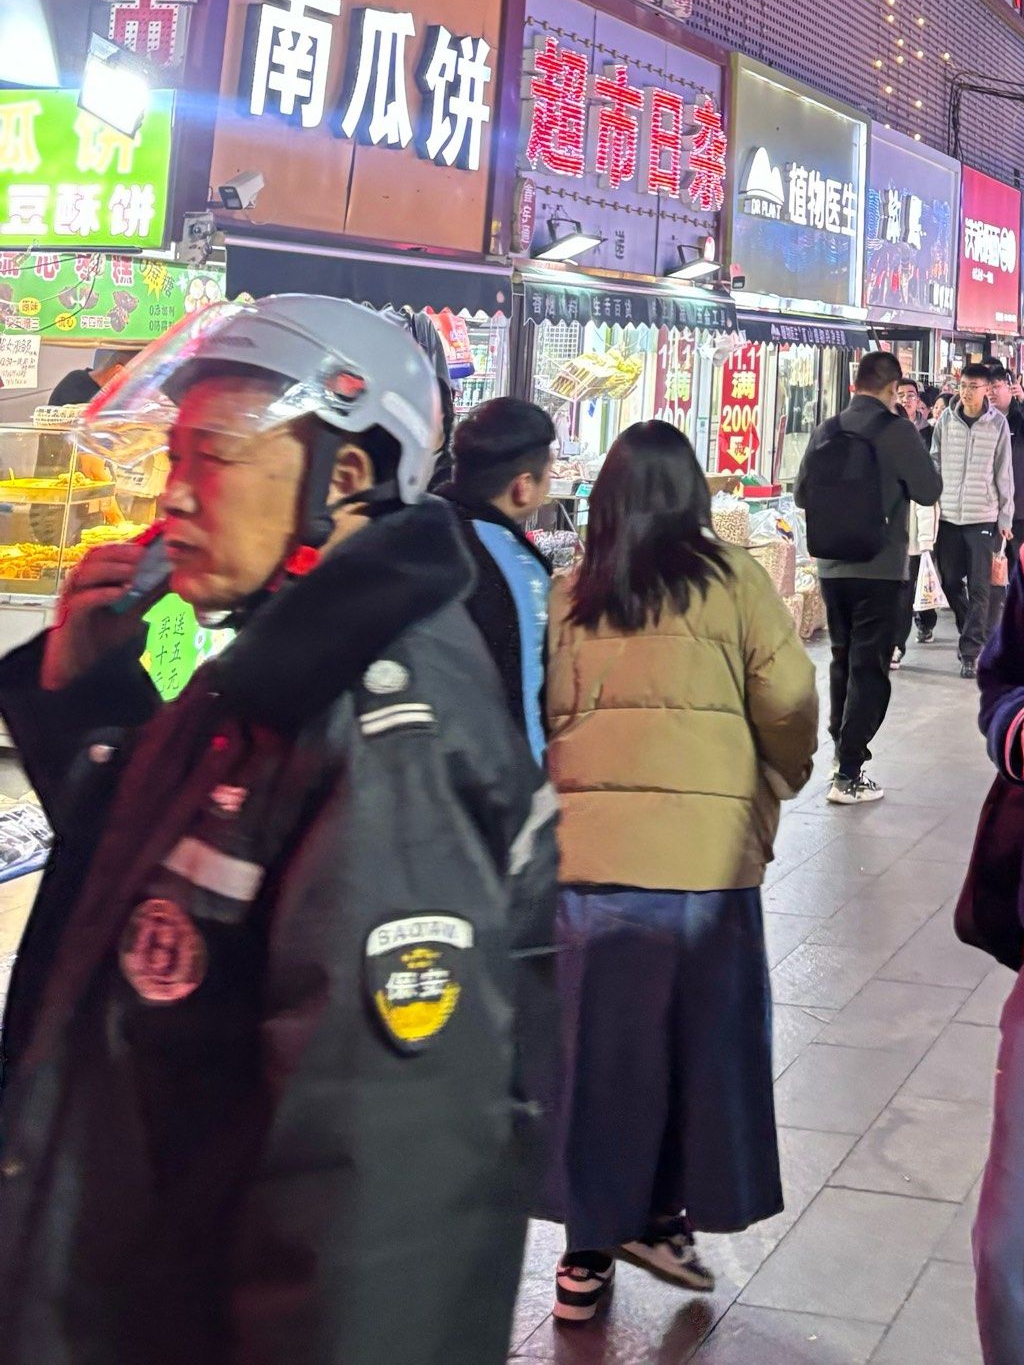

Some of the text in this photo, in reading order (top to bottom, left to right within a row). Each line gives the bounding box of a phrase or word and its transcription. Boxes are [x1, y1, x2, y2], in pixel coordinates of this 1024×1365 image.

[526, 35, 727, 211] 超市日杂
[788, 161, 856, 235] 植物医生
[731, 371, 757, 400] 满
